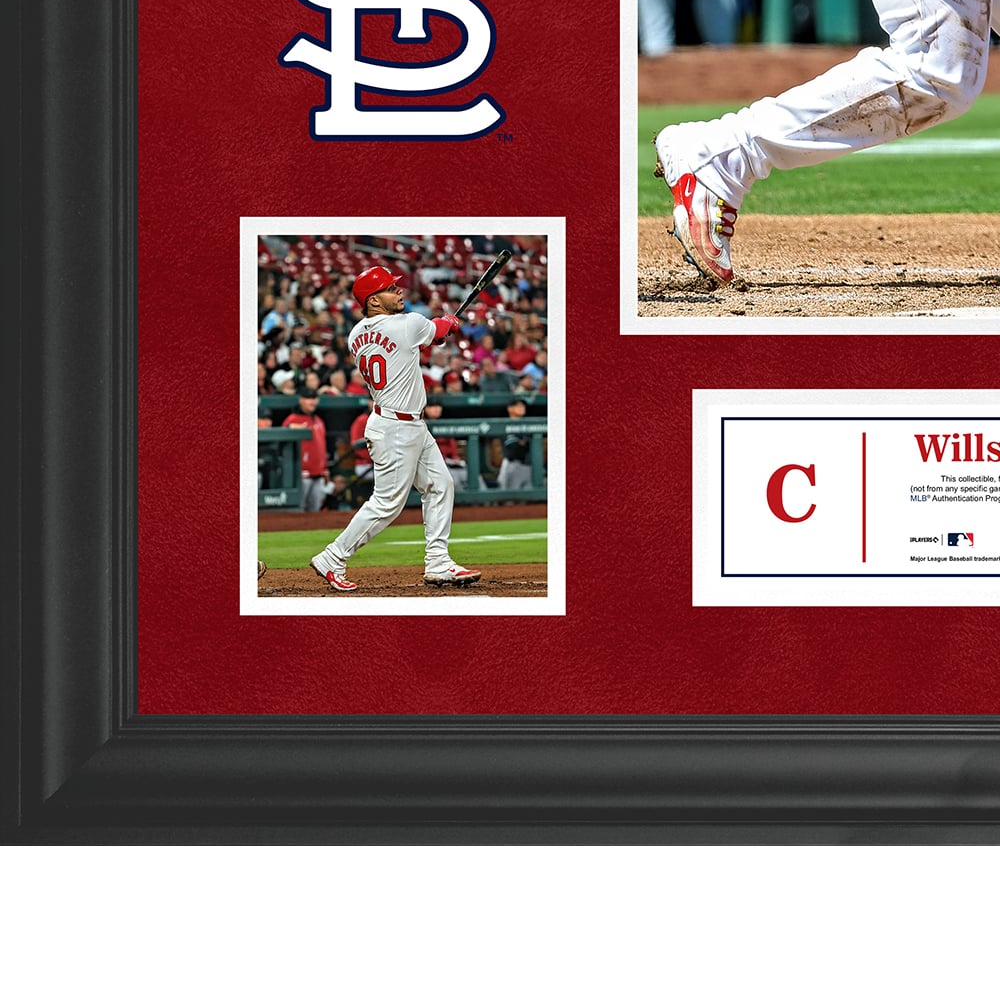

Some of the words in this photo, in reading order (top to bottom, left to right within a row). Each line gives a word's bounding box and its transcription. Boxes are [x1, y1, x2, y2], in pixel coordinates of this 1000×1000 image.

[766, 464, 816, 523] C
[910, 485, 925, 493] (not
[960, 485, 987, 493] specific
